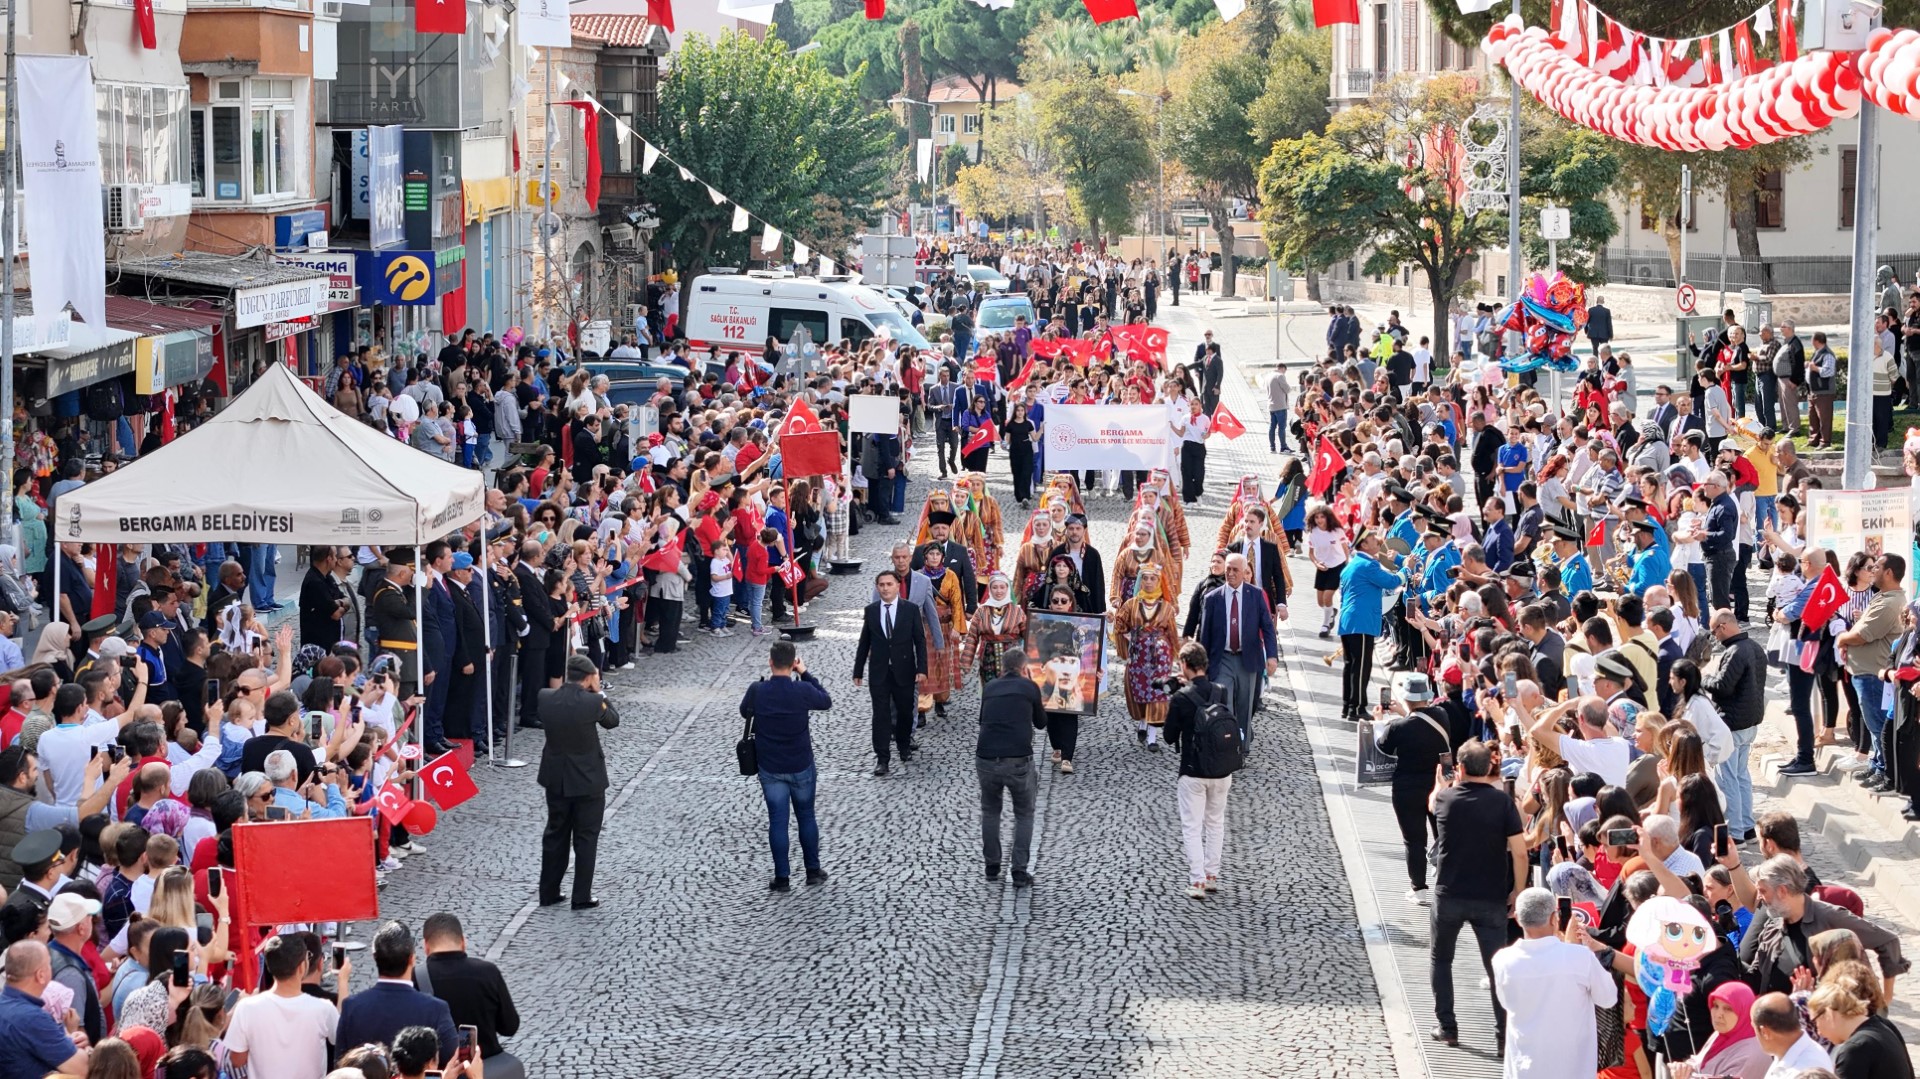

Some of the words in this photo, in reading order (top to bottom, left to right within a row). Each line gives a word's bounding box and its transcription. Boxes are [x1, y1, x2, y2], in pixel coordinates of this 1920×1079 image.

[338, 291, 349, 299] 72
[239, 293, 267, 316] UYGUN
[729, 306, 740, 315] T.C.
[710, 314, 728, 324] SAĞLIK
[729, 315, 757, 326] BAKANLIĞI
[722, 324, 745, 339] 112
[1077, 437, 1100, 445] GENÇLİK
[119, 514, 197, 532] BERGAMA
[201, 510, 294, 533] BELEDİYESİ
[1861, 514, 1895, 530] EKİM
